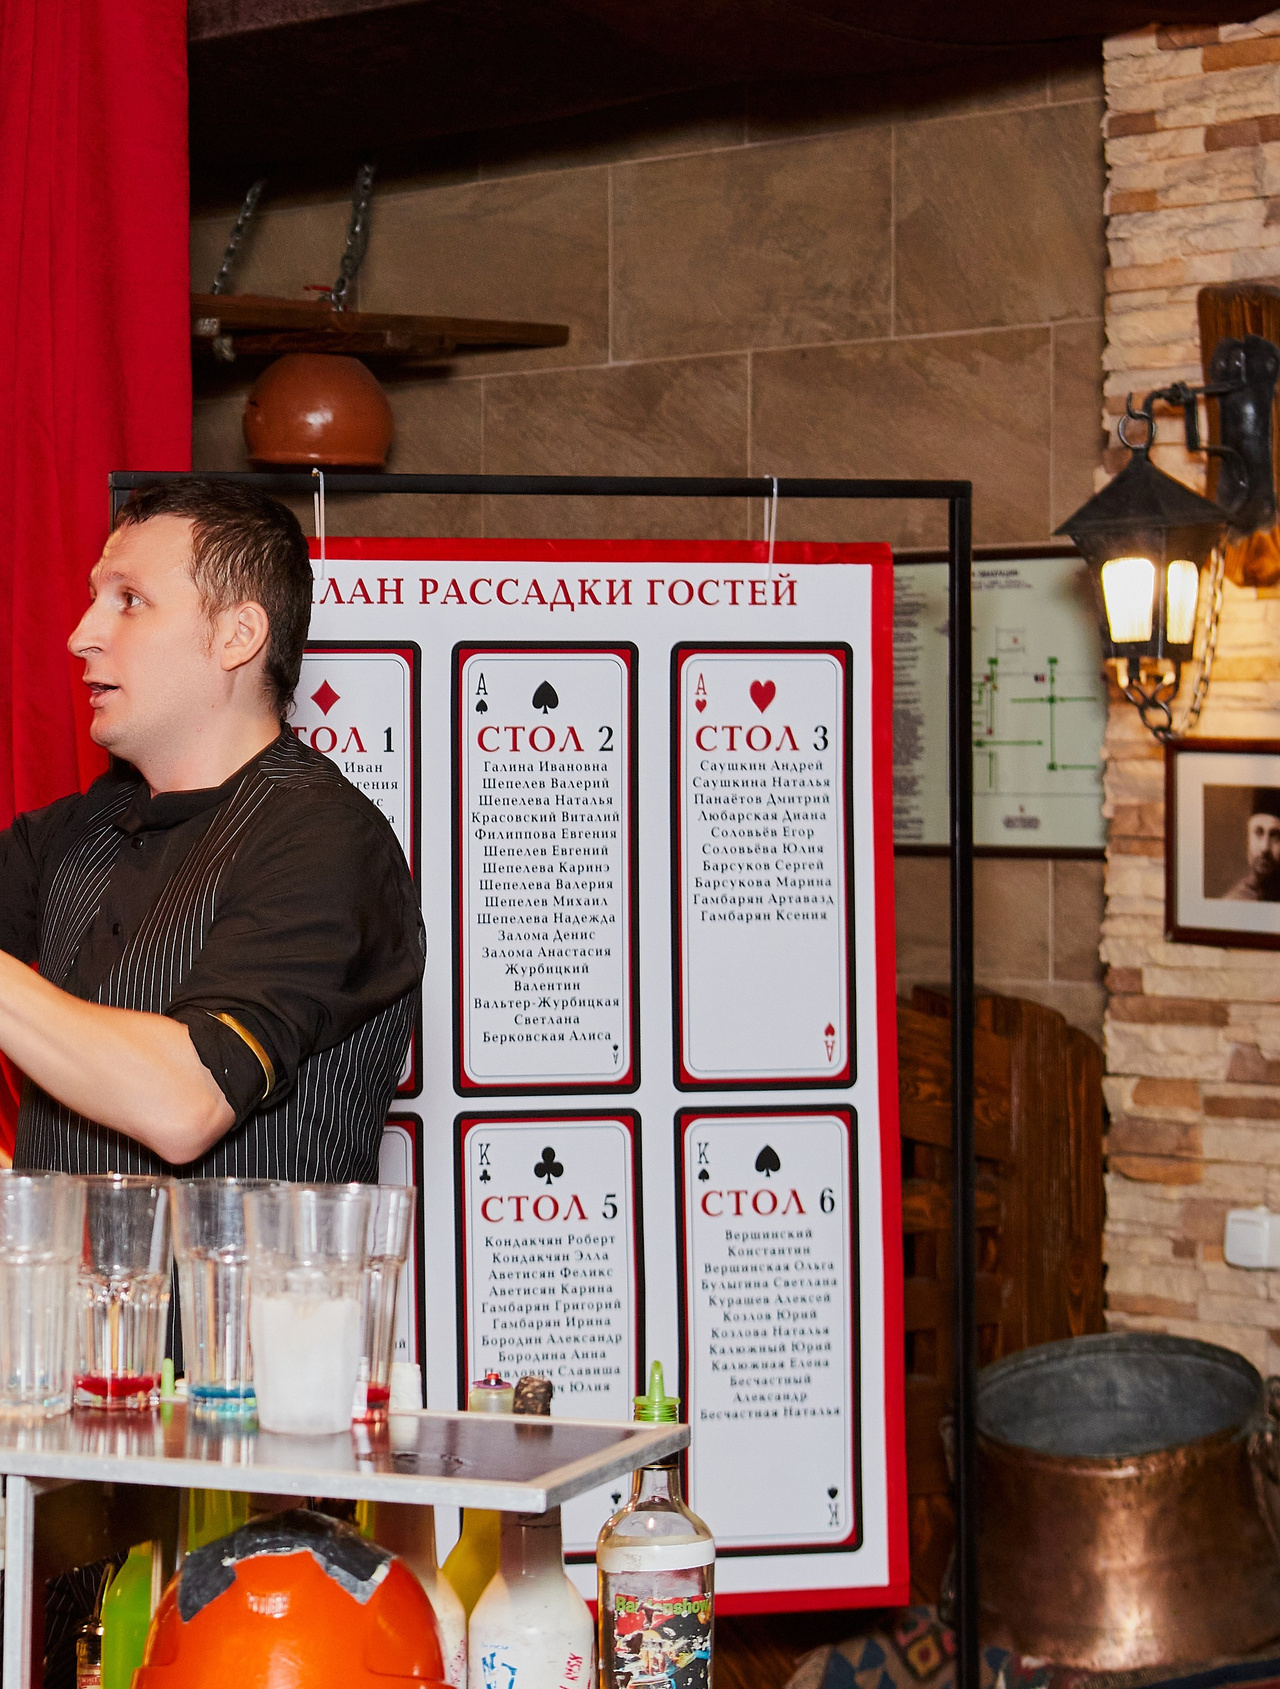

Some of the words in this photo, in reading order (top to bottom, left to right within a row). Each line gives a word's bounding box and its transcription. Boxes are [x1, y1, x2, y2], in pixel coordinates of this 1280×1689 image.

[313, 578, 404, 605] ЛАН
[419, 578, 632, 612] РАССАДКИ
[647, 574, 797, 606] ГОСТЕЙ
[476, 673, 488, 695] A
[695, 673, 707, 695] A
[384, 727, 394, 752] 1
[477, 726, 584, 752] СТОЛ
[598, 726, 613, 751] 2
[695, 725, 799, 752] СТОЛ
[813, 726, 828, 751] 3
[344, 762, 382, 772] Иван
[484, 761, 534, 772] Галина
[539, 761, 607, 772] Ивановна
[700, 760, 766, 773] Саушкин
[771, 760, 822, 772] Андрей
[351, 781, 398, 789] гения
[483, 778, 545, 788] Шепелев
[551, 778, 609, 790] Валерий
[693, 777, 766, 789] Саушкина
[772, 777, 829, 787] Наталья
[479, 795, 550, 806] Шепелева
[555, 795, 613, 805] Наталья
[694, 794, 762, 804] Панаётов
[766, 793, 829, 806] Дмитрий
[472, 812, 556, 825] Красовский
[561, 811, 619, 822] Виталий
[698, 811, 777, 822] Любарская
[782, 810, 826, 822] Диана
[475, 829, 556, 840] Филиппова
[562, 829, 616, 839] Евгения
[711, 827, 777, 837] Соловьёв
[783, 827, 814, 838] Егор
[484, 846, 546, 856] Шепелев
[552, 845, 608, 856] Евгений
[702, 844, 777, 854] Соловьёва
[783, 843, 823, 854] Юлия
[483, 863, 554, 873] Шепелева
[559, 862, 609, 874] Каринэ
[703, 860, 770, 873] Барсуков
[775, 860, 823, 872] Сергей
[479, 880, 550, 890] Шепелева
[556, 879, 613, 891] Валерия
[695, 877, 771, 890] Барсукова
[776, 876, 832, 888] Марина
[485, 897, 548, 907] Шепелев
[553, 896, 608, 906] Михаил
[694, 895, 763, 906] Гамбарян
[768, 894, 834, 905] Артавазд
[477, 914, 548, 924] Шепелева
[553, 913, 615, 925] Надежда
[701, 911, 770, 923] Гамбарян
[776, 910, 827, 920] Ксения
[498, 930, 548, 941] Залома
[553, 930, 595, 942] Денис
[482, 947, 533, 958] Залома
[538, 947, 611, 957] Анастасия
[505, 963, 589, 977] Журбицкий
[514, 981, 580, 991] Валентин
[474, 997, 619, 1010] Вальтер-Журбицкая
[514, 1014, 579, 1025] Светлана
[483, 1032, 564, 1044] Берковская
[570, 1031, 611, 1041] Алиса
[479, 1143, 491, 1165] K
[698, 1142, 709, 1164] K
[481, 1195, 588, 1222] СТОЛ
[602, 1194, 617, 1220] 5
[701, 1189, 806, 1217] СТОЛ
[820, 1188, 835, 1214] 6
[485, 1236, 562, 1248] Кондакчян
[568, 1234, 615, 1245] Роберт
[725, 1229, 812, 1242] Вершинский
[492, 1253, 569, 1264] Кондакчян
[575, 1250, 608, 1261] Элла
[728, 1246, 810, 1257] Константин
[488, 1268, 554, 1280] Аветисян
[561, 1267, 612, 1279] Феликс
[704, 1263, 789, 1276] Вершинская
[795, 1261, 833, 1272] Ольга
[773, 1278, 837, 1288] Светлана
[489, 1286, 555, 1297] Аветисян
[561, 1284, 612, 1295] Карина
[774, 1294, 831, 1303] Алексей
[482, 1302, 549, 1313] Гамбарян
[555, 1299, 621, 1311] Григорий
[777, 1309, 817, 1321] Юрий
[493, 1319, 560, 1330] Гамбарян
[566, 1317, 611, 1328] Ирина
[773, 1326, 829, 1336] Наталья
[482, 1336, 541, 1347] Бородин
[547, 1333, 622, 1344] Александр
[791, 1342, 831, 1353] Юрий
[499, 1352, 566, 1363] Бородина
[571, 1350, 606, 1360] Анна
[790, 1359, 829, 1369] Елена
[558, 1365, 620, 1376] Славиша
[570, 1382, 610, 1392] Юлия
[734, 1391, 807, 1402] Александр
[783, 1406, 840, 1418] Наталья
